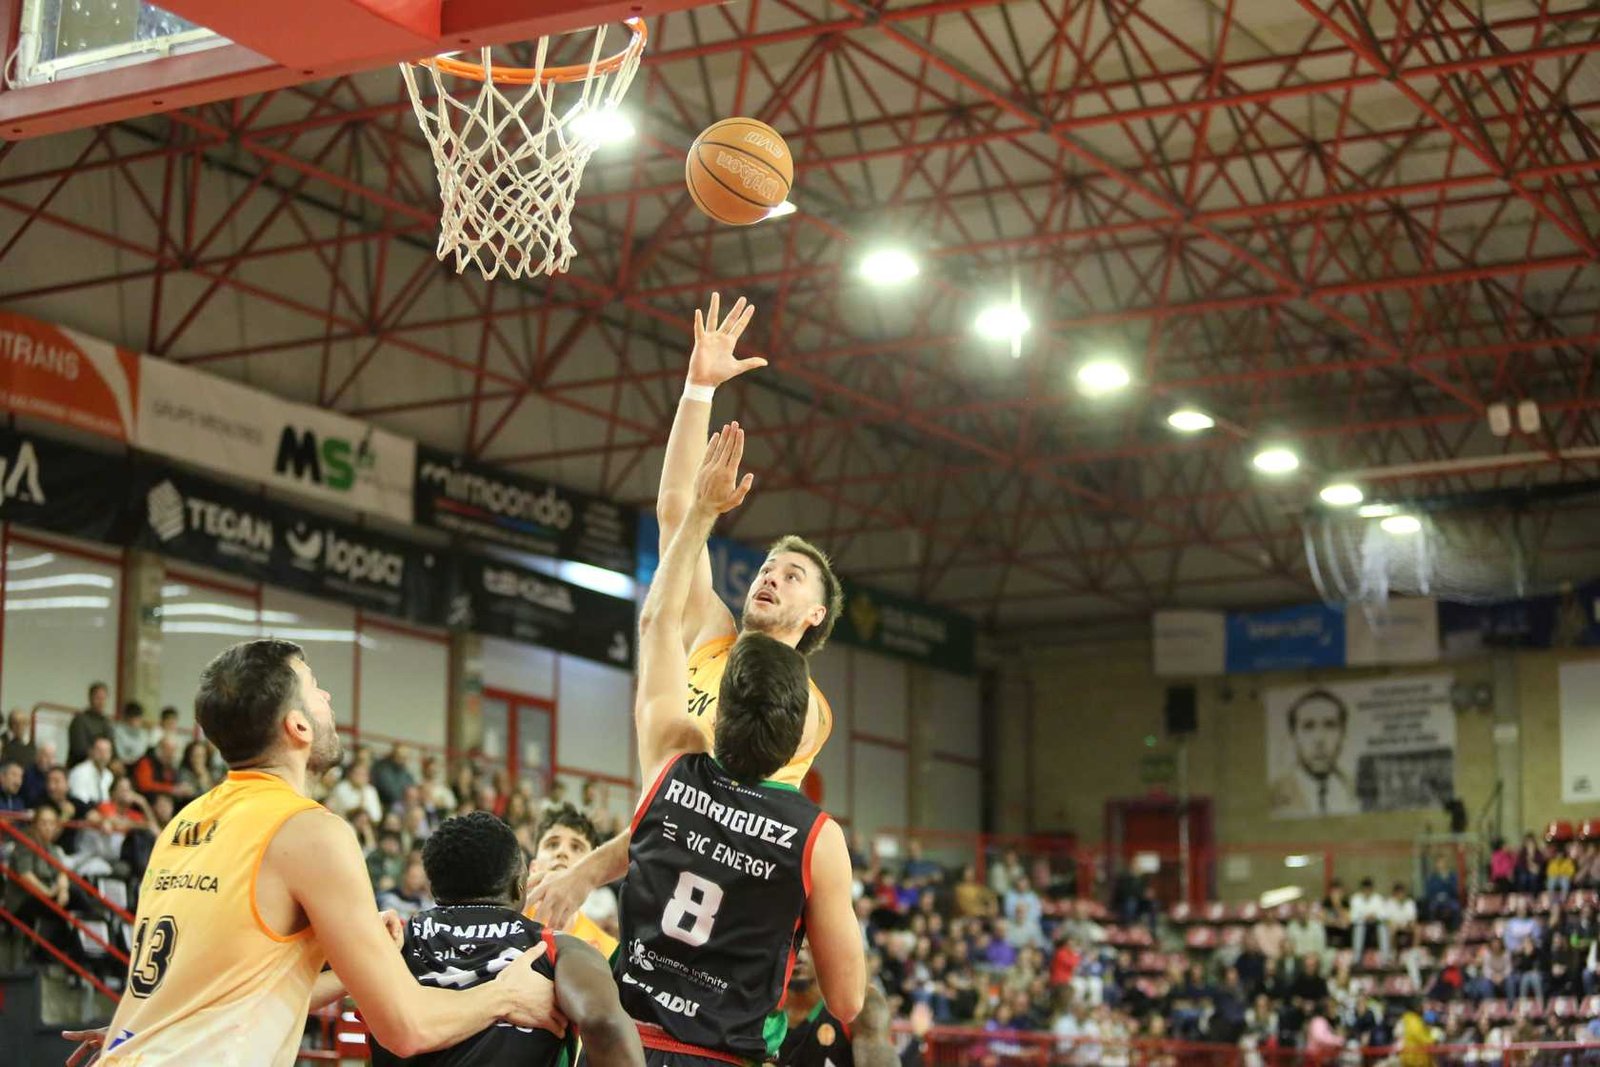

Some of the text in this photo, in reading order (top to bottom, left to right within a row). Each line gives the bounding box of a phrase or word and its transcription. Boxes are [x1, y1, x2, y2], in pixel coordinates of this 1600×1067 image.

[275, 425, 356, 491] MS
[186, 499, 274, 550] TECAN
[325, 529, 404, 587] lopsa
[664, 779, 798, 849] RODRIGUEZ
[711, 843, 776, 880] ENERGY
[661, 870, 724, 947] 8
[129, 915, 179, 999] 13
[647, 951, 690, 973] Quimera
[691, 969, 728, 989] Infinita
